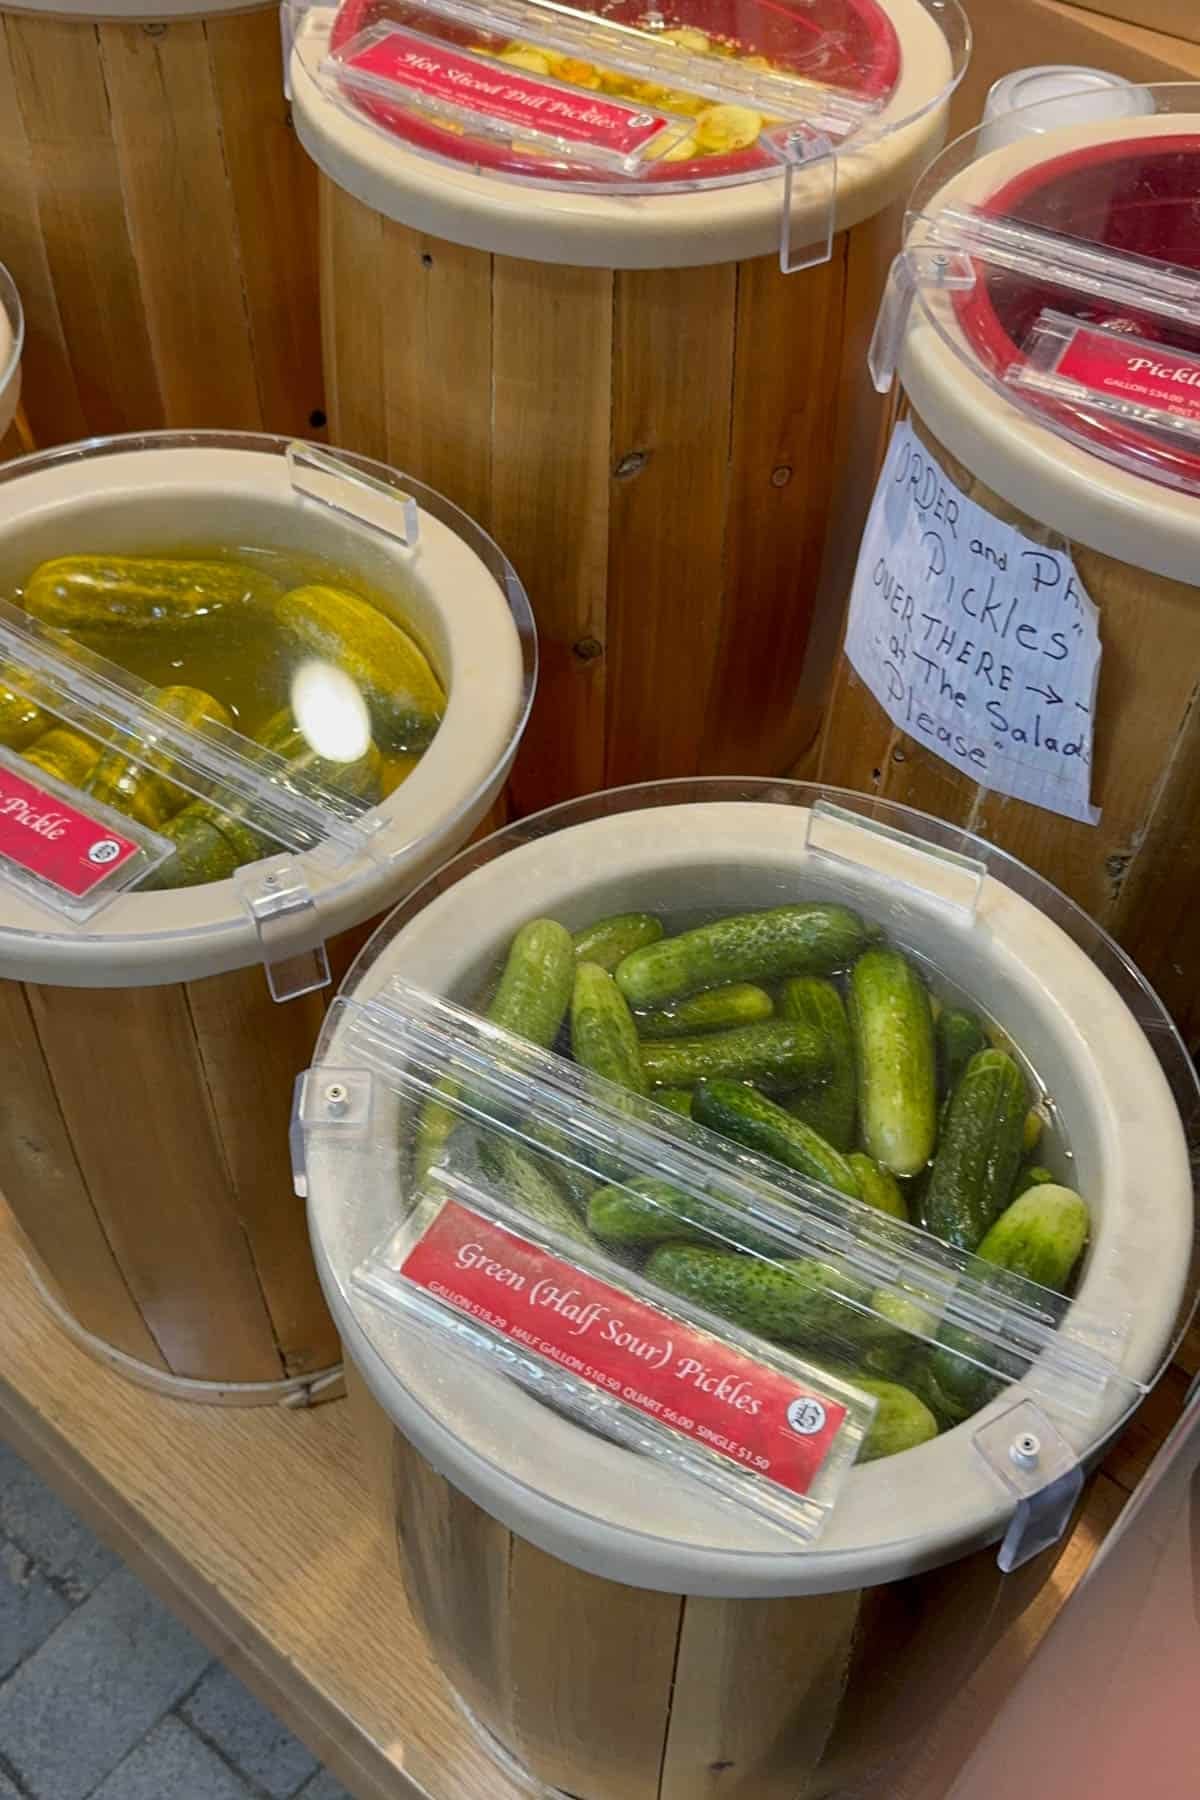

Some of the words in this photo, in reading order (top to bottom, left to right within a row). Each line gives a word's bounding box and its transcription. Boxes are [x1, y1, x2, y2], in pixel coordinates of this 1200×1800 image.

[398, 53, 440, 73] Hot
[446, 68, 508, 95] Sliced
[545, 101, 616, 129] Pickles
[896, 441, 959, 539] ORDER
[969, 539, 1008, 571] and
[873, 558, 913, 633] OVER
[920, 613, 1014, 692] THERE
[912, 650, 967, 709] The
[0, 797, 72, 841] Pickle
[427, 1280, 472, 1310] GALLON
[510, 1326, 539, 1346] HALF
[538, 1341, 586, 1372] GALLON
[623, 1386, 664, 1412] QUART
[696, 1425, 738, 1452] SINGLE
[737, 1446, 770, 1471] $1.50
[455, 1243, 527, 1292] Green
[529, 1278, 610, 1336] (Half
[600, 1319, 673, 1369] Sour)
[674, 1358, 764, 1416] Pickles
